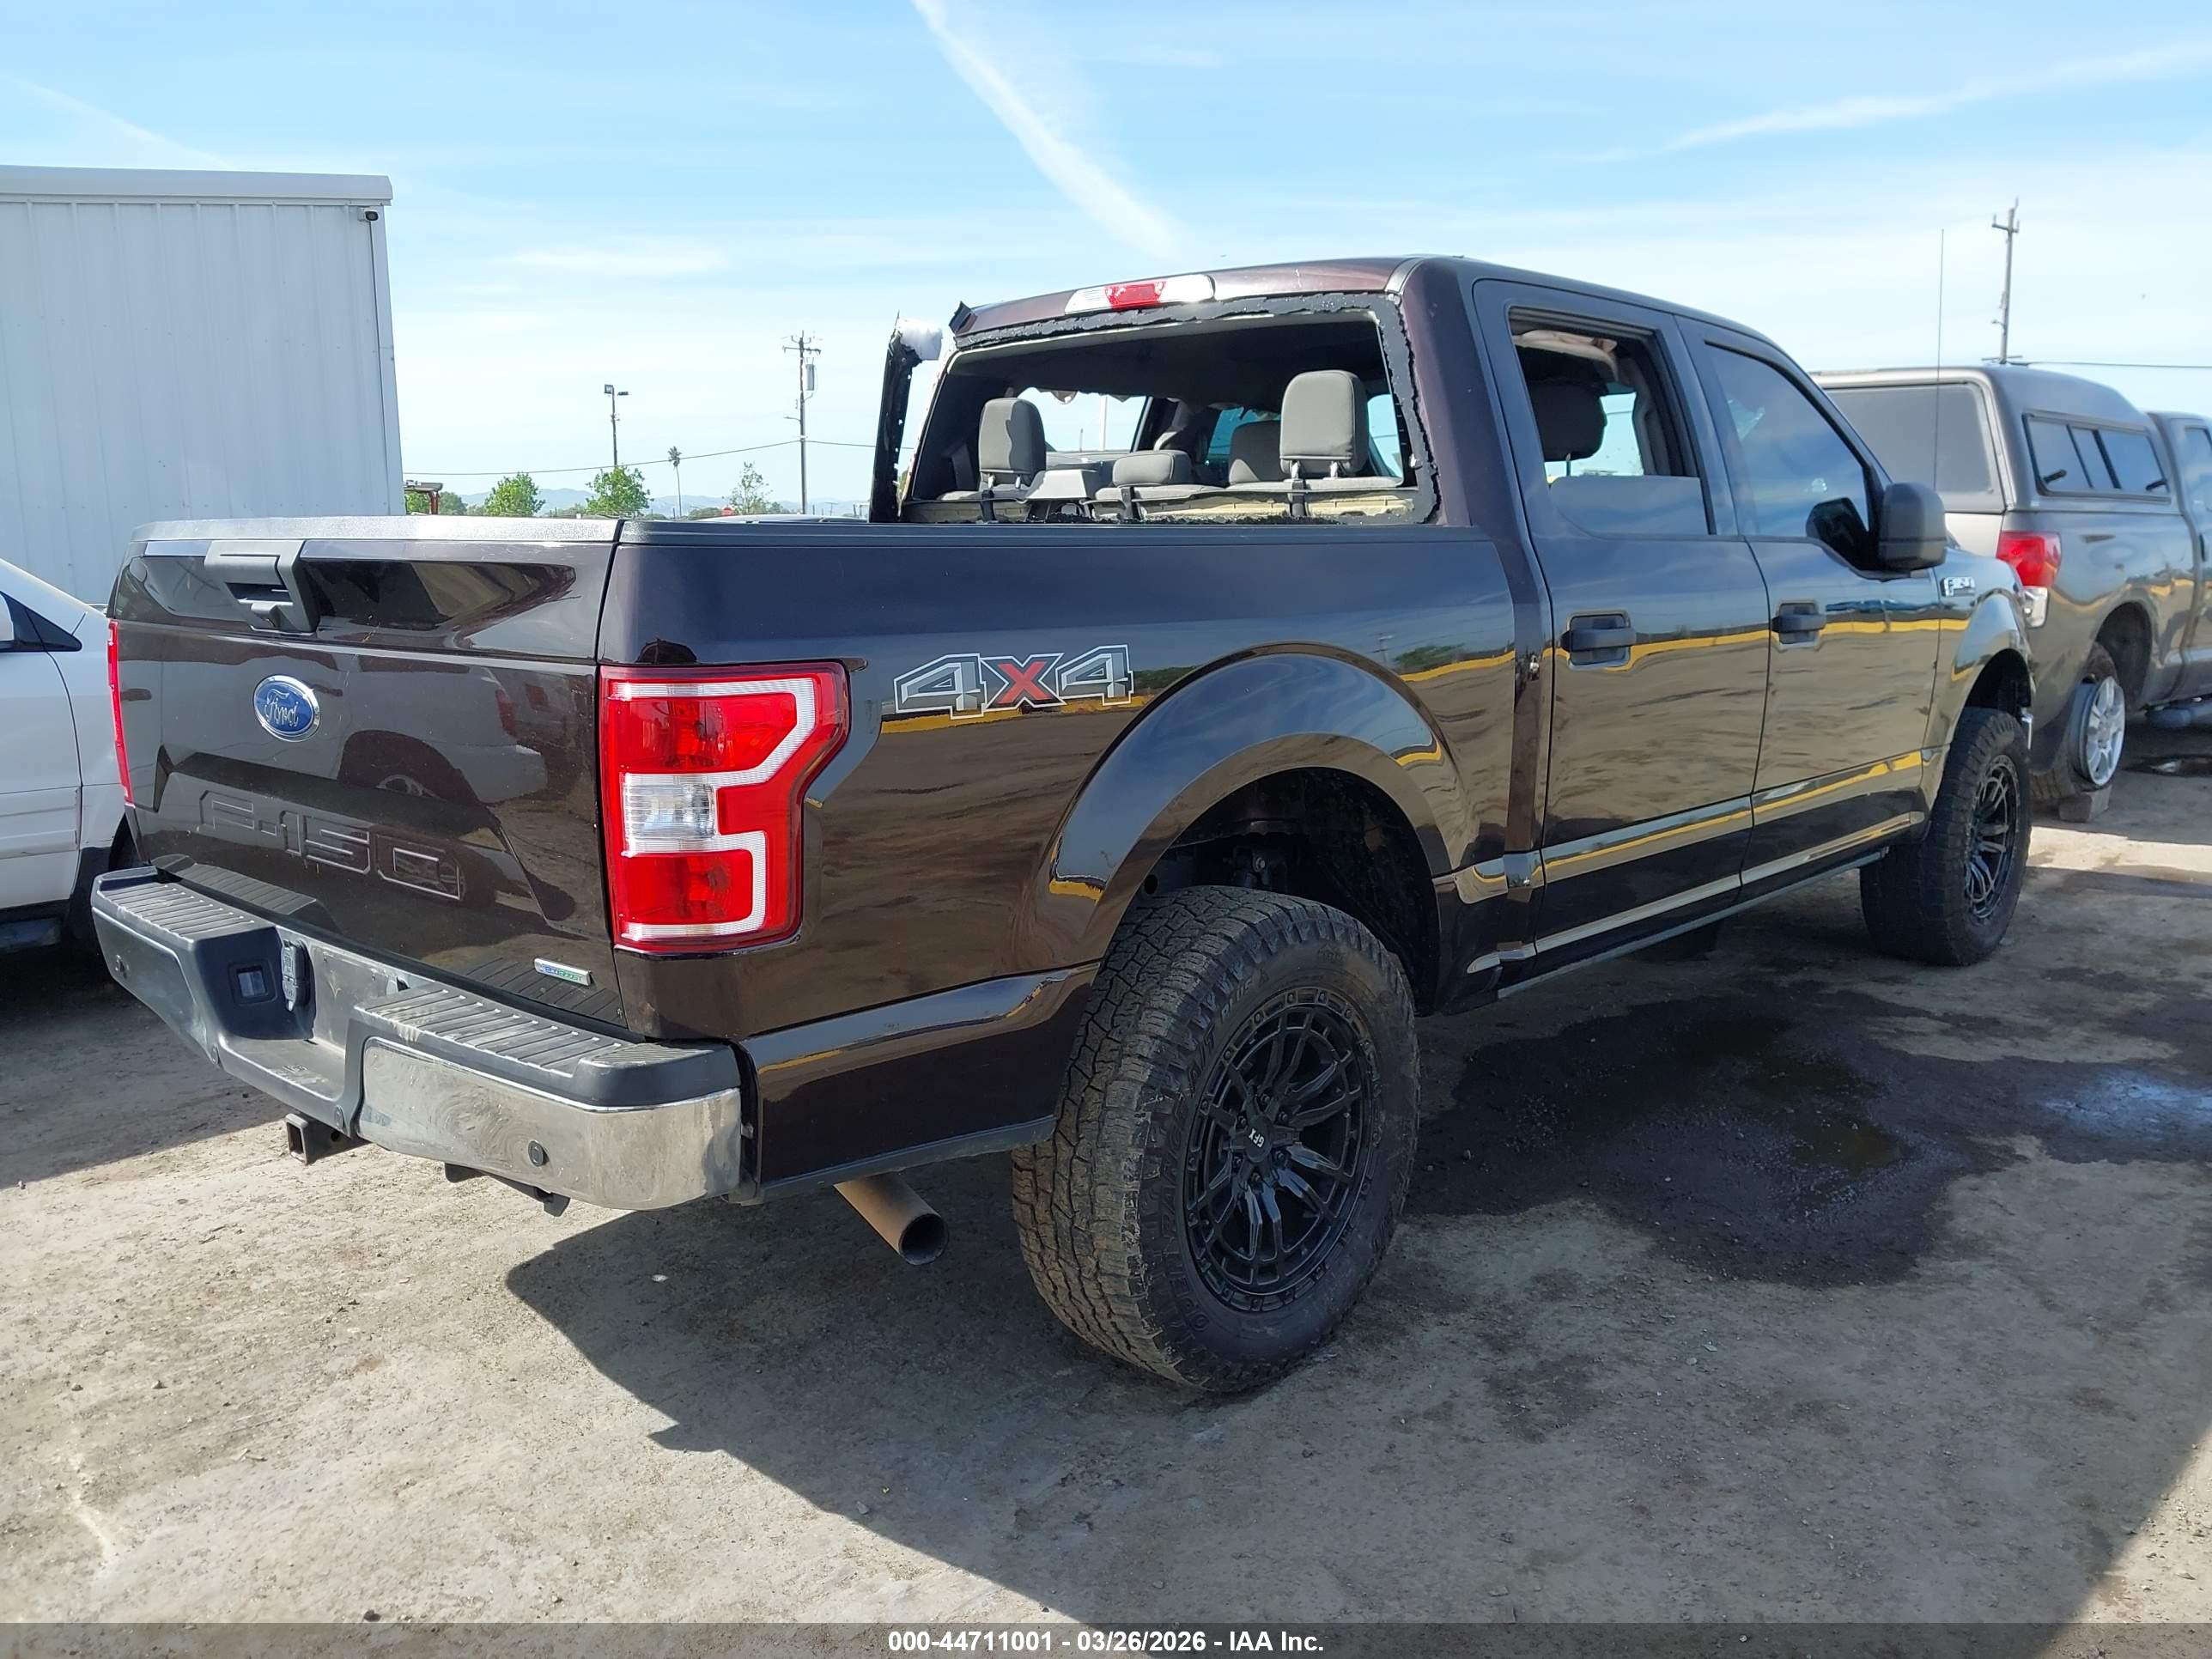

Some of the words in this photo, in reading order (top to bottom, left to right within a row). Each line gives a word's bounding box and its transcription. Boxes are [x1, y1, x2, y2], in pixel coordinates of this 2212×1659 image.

[264, 688, 299, 727] Ford
[199, 789, 465, 901] F-150
[1188, 1022, 1217, 1092] A/T
[1220, 975, 1252, 1023] PLUS
[1248, 1127, 1265, 1148] GFX
